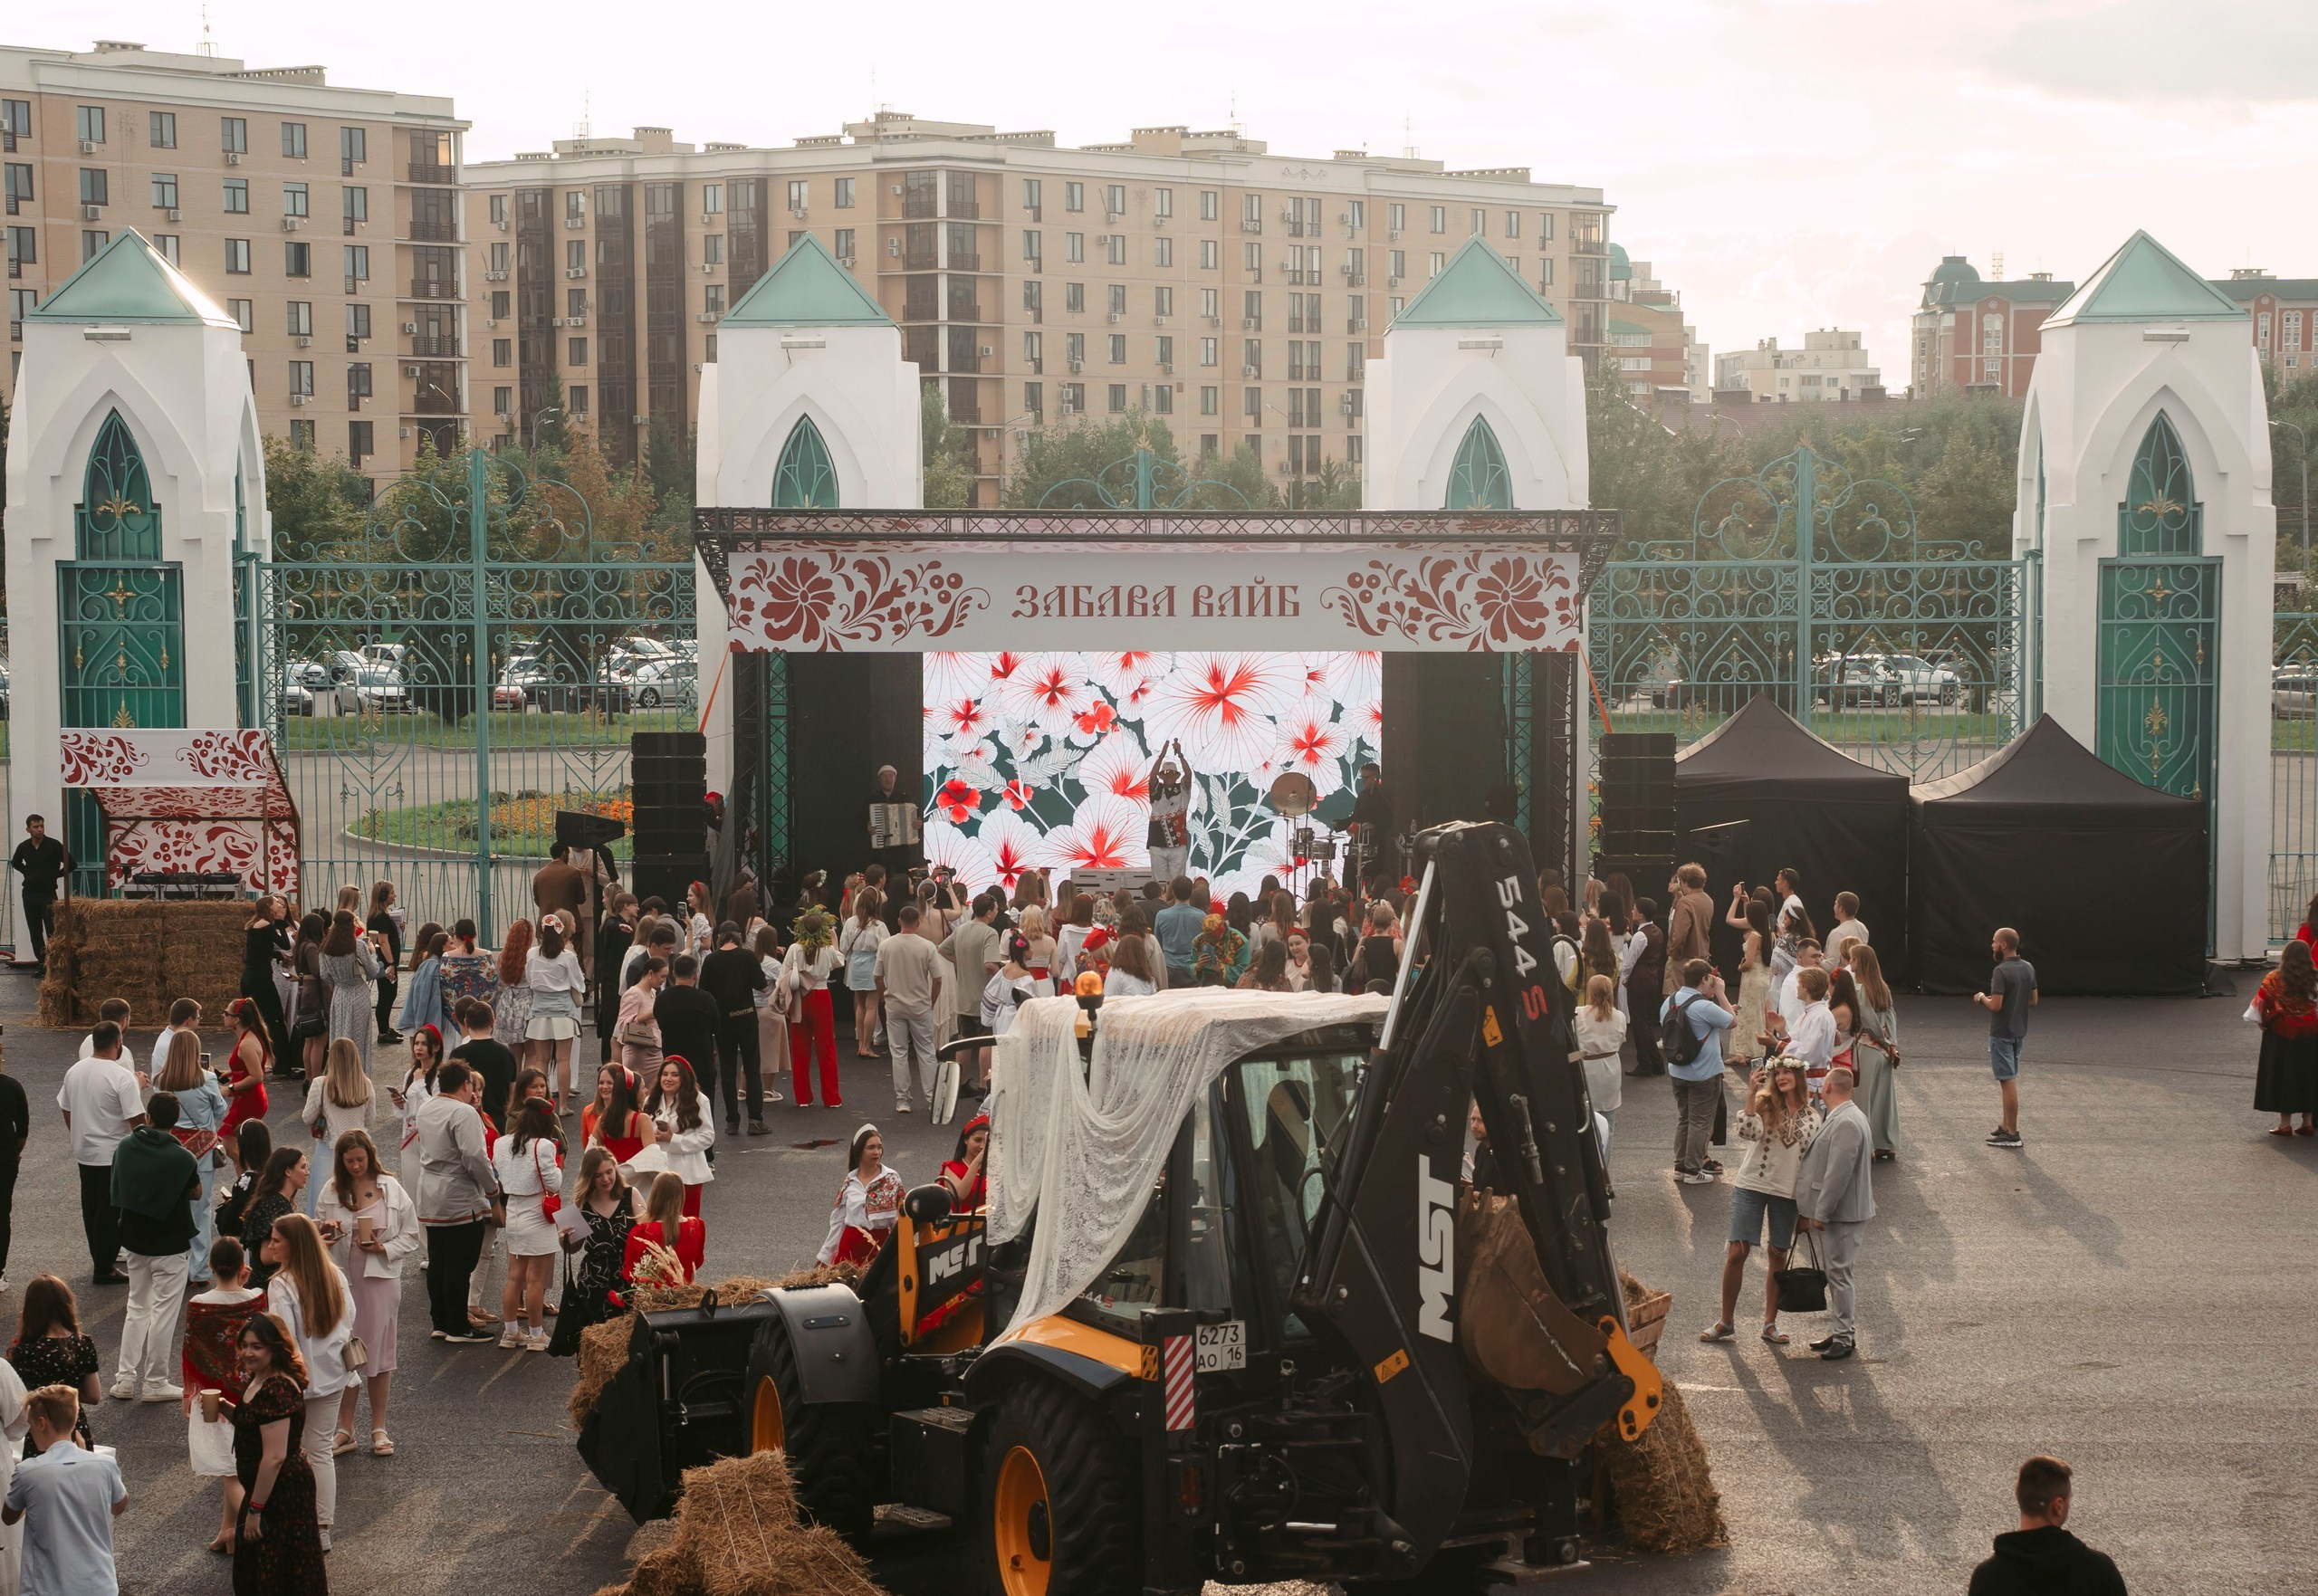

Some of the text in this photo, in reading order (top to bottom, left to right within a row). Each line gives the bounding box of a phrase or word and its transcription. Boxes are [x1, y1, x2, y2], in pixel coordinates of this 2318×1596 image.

[1011, 575, 1300, 618] ЗАБАВА ВАЙБ
[929, 1234, 983, 1285] MST
[1418, 1153, 1454, 1343] MST
[1199, 1324, 1239, 1346] 6273
[1227, 1346, 1242, 1362] 16
